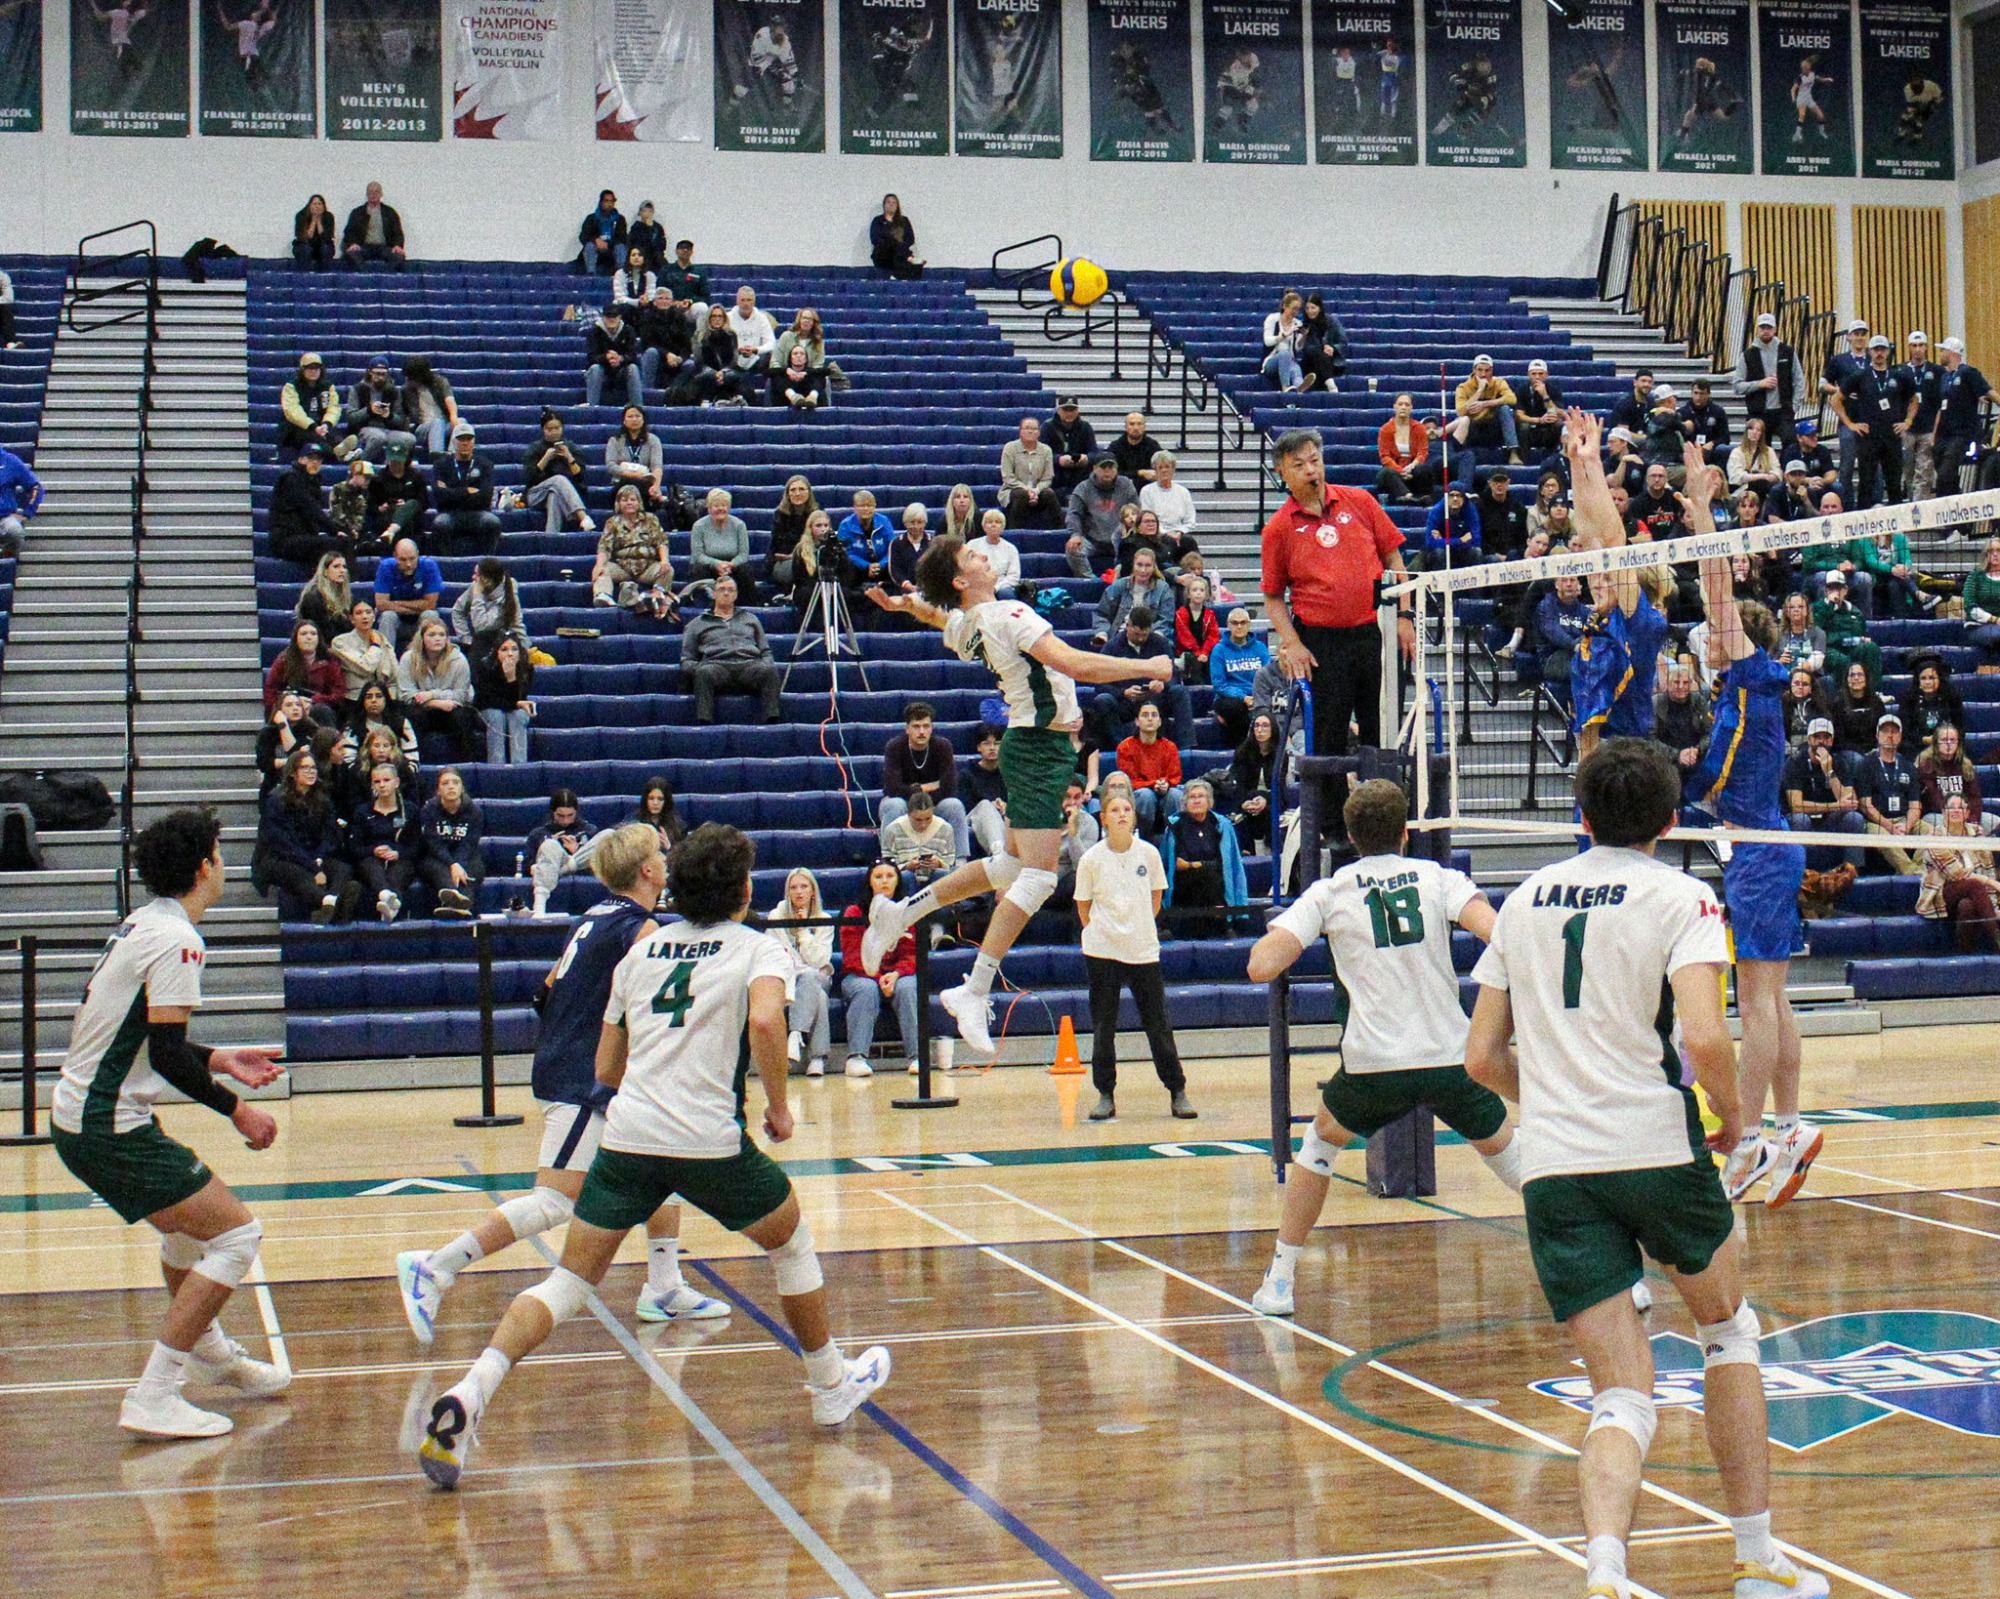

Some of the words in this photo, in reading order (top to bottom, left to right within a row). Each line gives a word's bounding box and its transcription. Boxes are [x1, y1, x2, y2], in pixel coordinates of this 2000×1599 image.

[977, 0, 1040, 11] LAKERS
[479, 7, 537, 17] NATIONAL
[460, 17, 558, 31] CHAMPIONS
[1111, 15, 1168, 29] LAKERS
[1337, 18, 1391, 33] LAKERS
[1224, 21, 1280, 36] LAKERS
[1446, 25, 1500, 40] LAKERS
[474, 30, 543, 41] CANADIENS
[1677, 31, 1729, 45] LAKERS
[1780, 34, 1831, 49] LAKERS
[472, 47, 545, 58] VOLLEYBALL
[1880, 44, 1931, 59] LAKERS
[478, 59, 539, 69] MASCULIN
[362, 83, 405, 93] MEN'S
[340, 96, 428, 109] VOLLEYBALL
[75, 110, 120, 119] FRANKIE
[124, 111, 187, 121] EDGECOMBE
[203, 110, 246, 119] FRANKIE
[251, 111, 314, 121] EDGECOMBE
[104, 121, 159, 129] 2012-2013
[231, 121, 286, 129] 2012-2013
[342, 119, 426, 131] 2012-2013
[739, 126, 768, 135] ZOSIA
[771, 127, 800, 136] DAVIS
[744, 136, 796, 144] 2014-2015
[957, 132, 1005, 141] STEPHANIE
[1008, 133, 1061, 142] ARMSTRONG
[869, 139, 920, 148] 2014-2015
[1115, 141, 1141, 149] ZOSIA
[1143, 141, 1170, 150] DAVIS
[1219, 142, 1245, 151] MARIA
[1336, 144, 1357, 152] ALEX
[1695, 162, 1716, 170] 2021
[1798, 165, 1819, 173] 2021
[1226, 660, 1262, 672] LAKERS
[1355, 871, 1419, 889] LAKERS
[1532, 883, 1628, 909] LAKERS
[1363, 886, 1425, 949] 18
[647, 940, 723, 960] LAKERS
[1561, 912, 1589, 1009] 1
[651, 961, 699, 1028] 4
